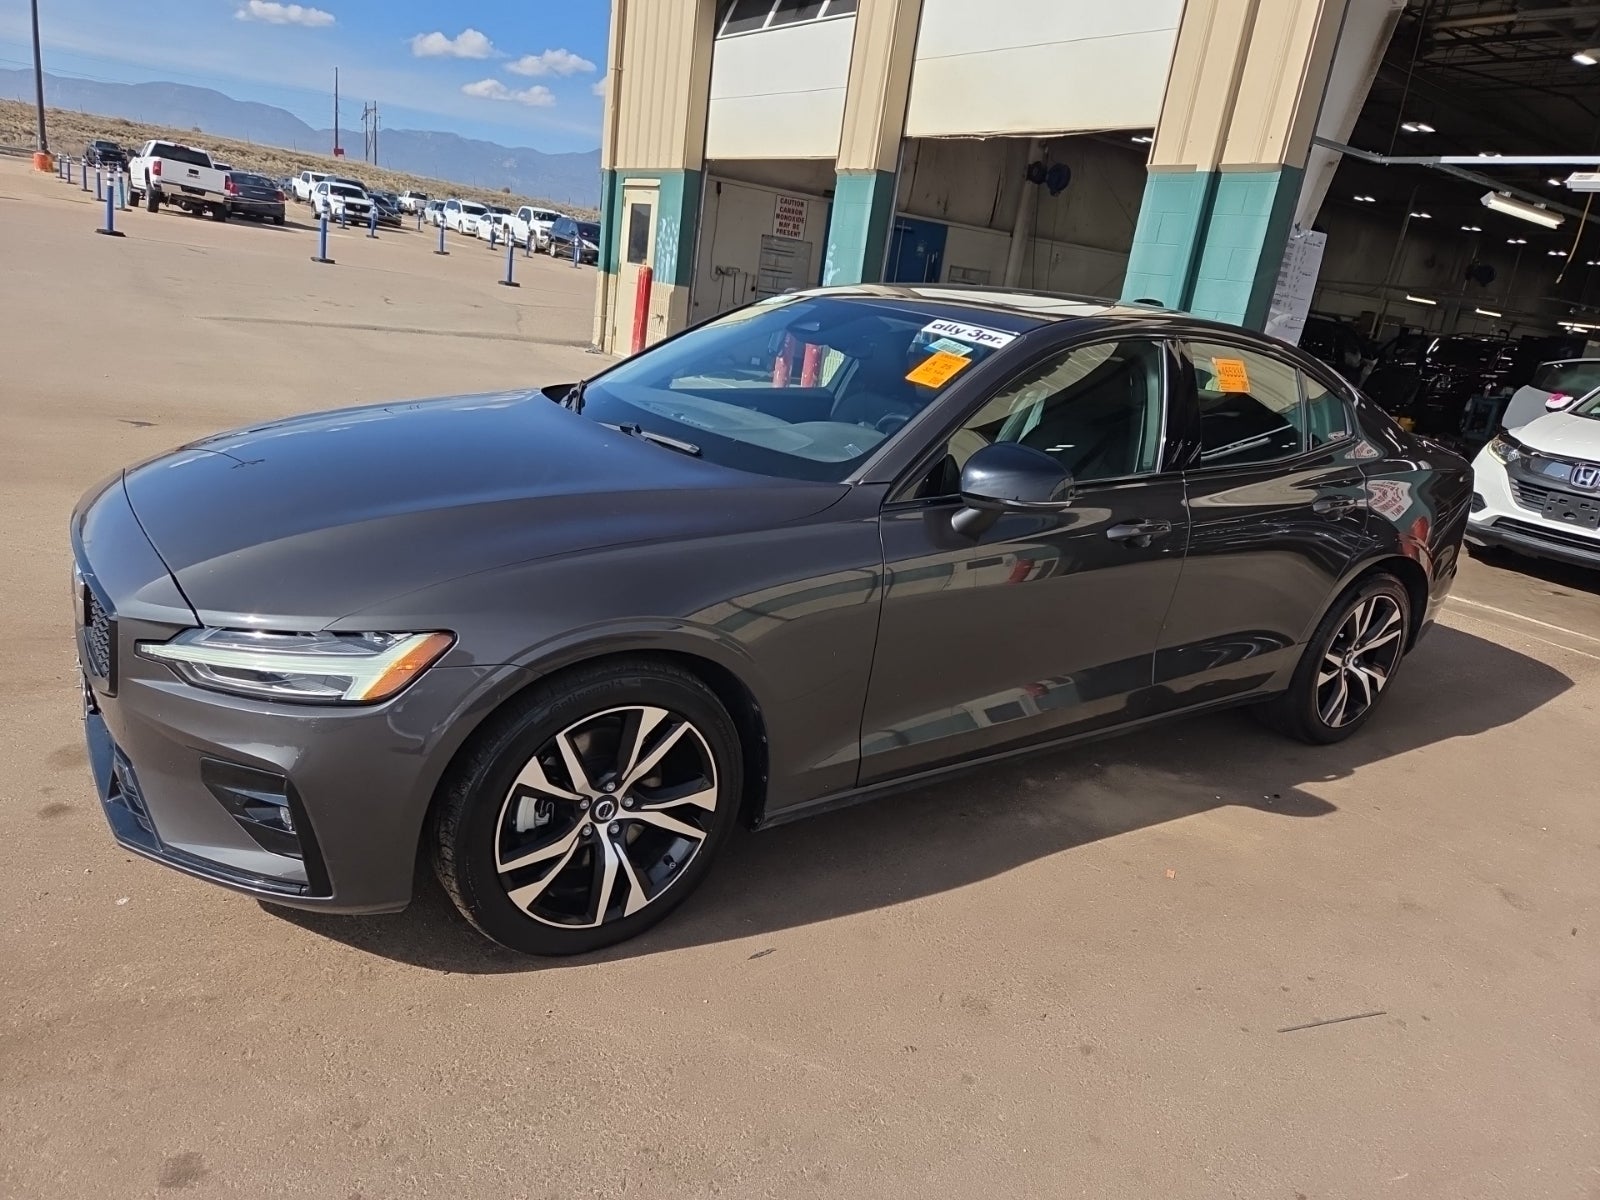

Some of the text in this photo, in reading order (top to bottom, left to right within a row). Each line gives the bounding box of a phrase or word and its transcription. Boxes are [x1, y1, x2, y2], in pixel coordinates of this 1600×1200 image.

[780, 198, 804, 207] CAUTION
[780, 207, 802, 216] CARBON
[776, 213, 805, 223] MONOXIDE
[776, 228, 801, 238] PRESENT
[932, 324, 967, 335] ally
